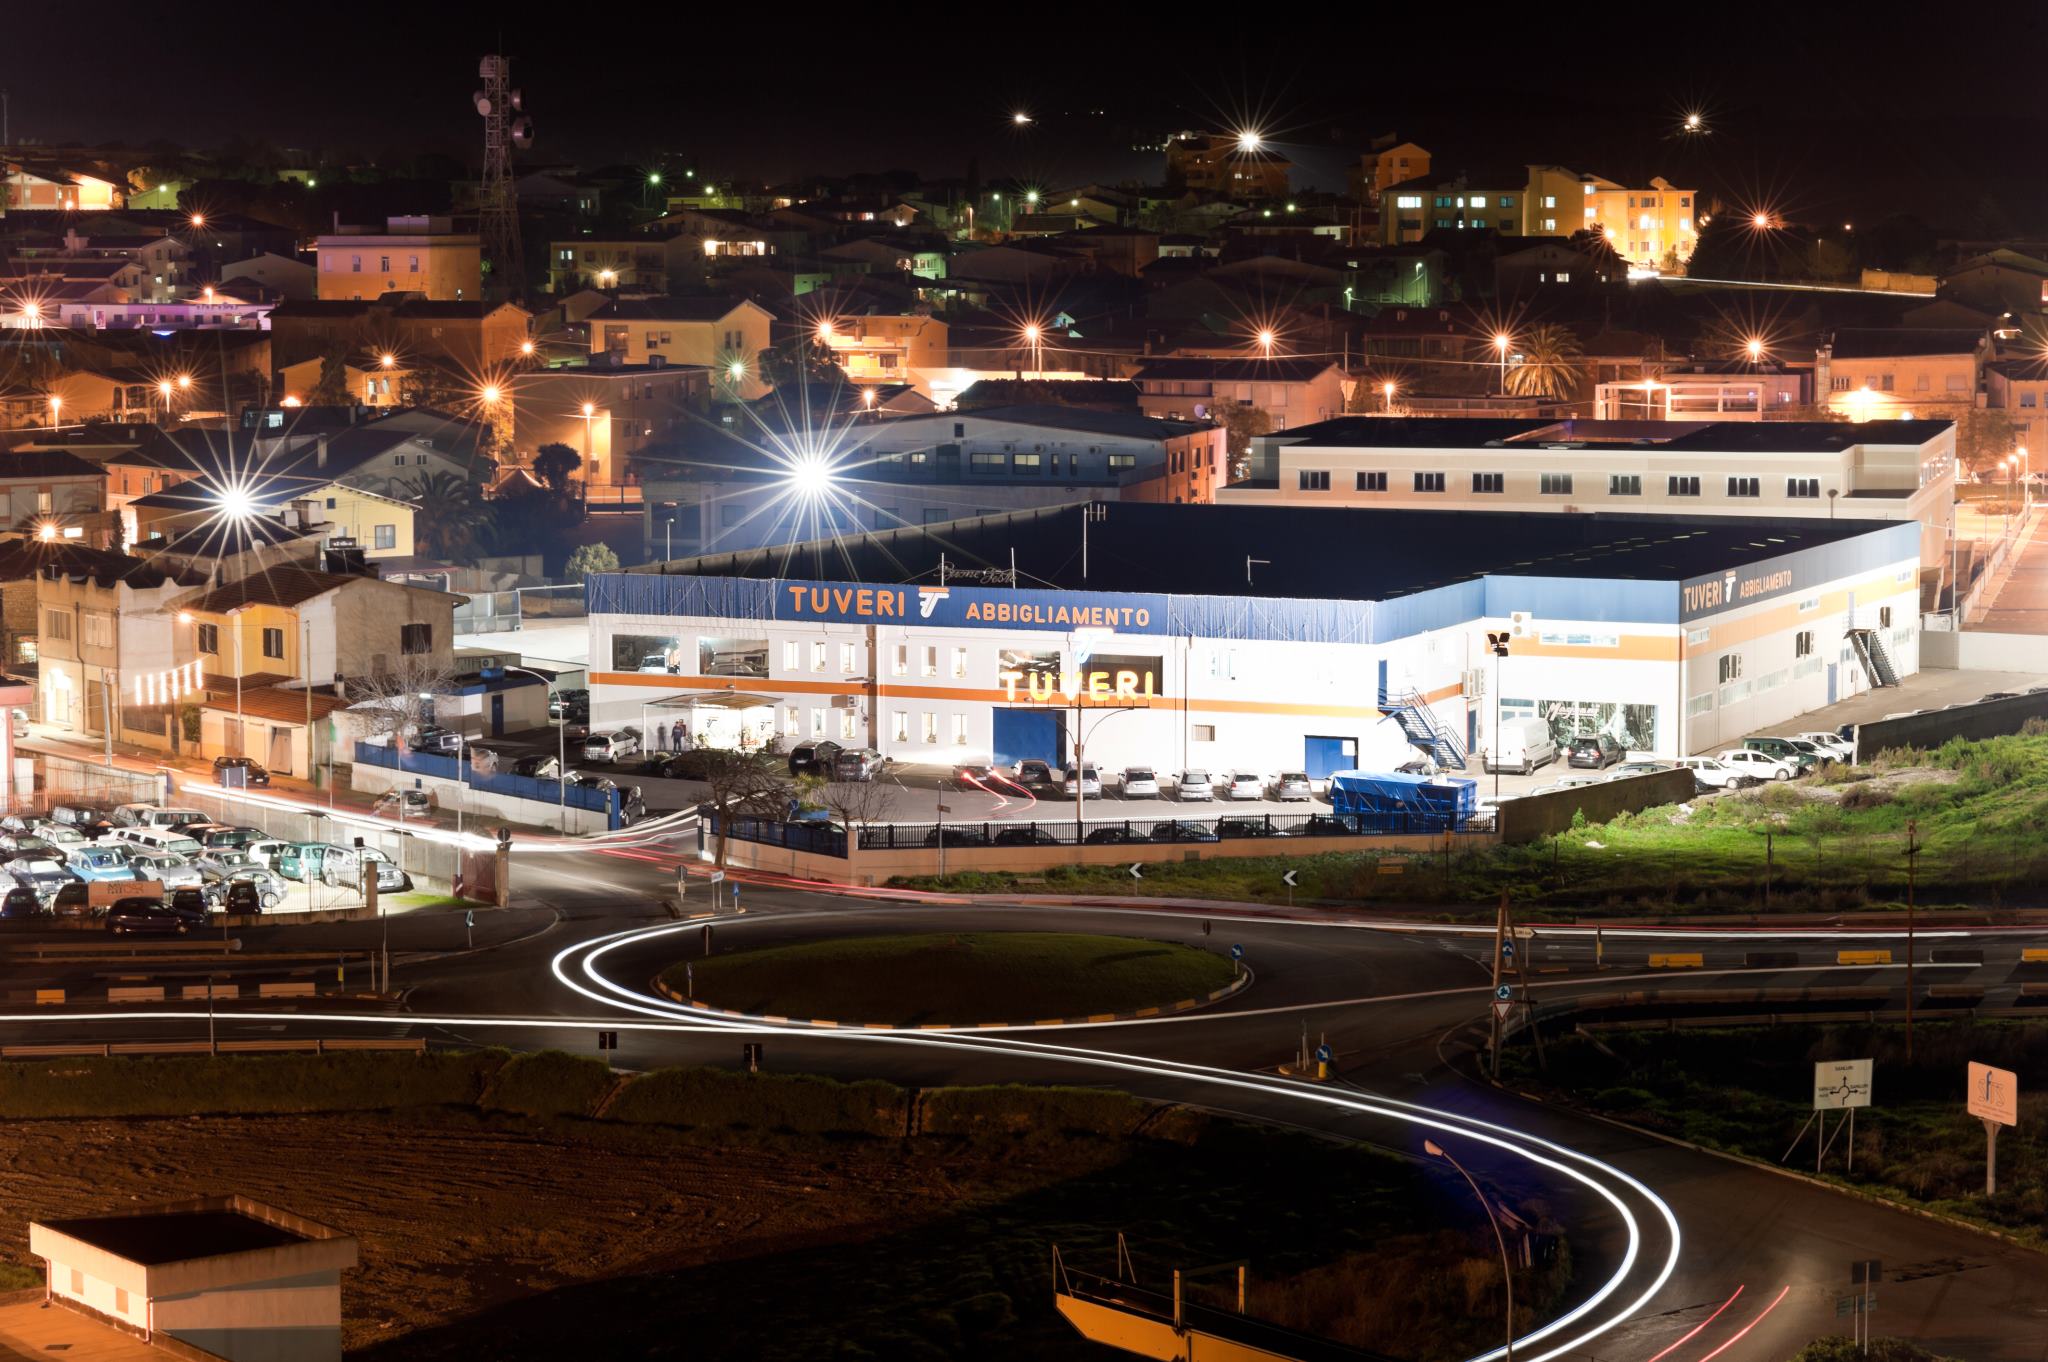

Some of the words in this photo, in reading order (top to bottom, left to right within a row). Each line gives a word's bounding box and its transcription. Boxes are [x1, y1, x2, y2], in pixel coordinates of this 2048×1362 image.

[788, 586, 905, 617] TUVERI
[965, 602, 1150, 627] ABBIGLIAMENTO
[1684, 580, 1722, 613] TUVERI
[1740, 570, 1792, 599] ABBIGLIAMENTO
[1000, 671, 1154, 702] TUVERI
